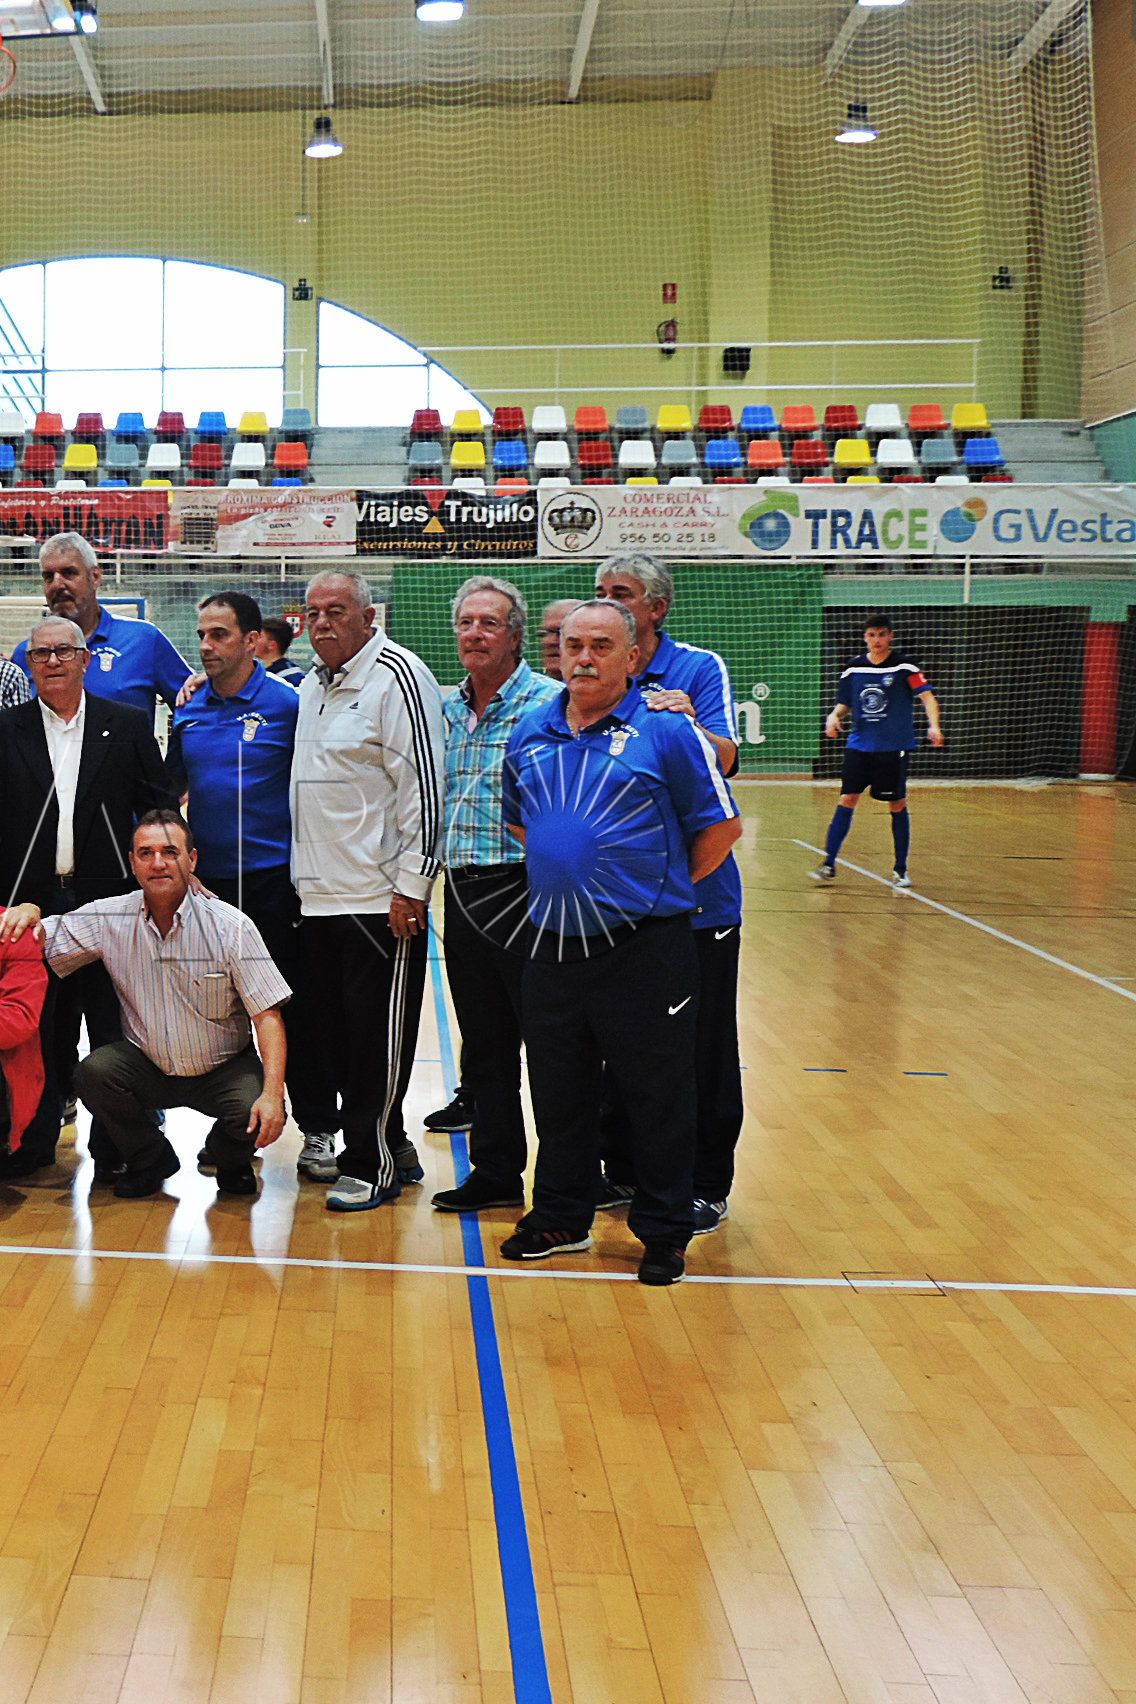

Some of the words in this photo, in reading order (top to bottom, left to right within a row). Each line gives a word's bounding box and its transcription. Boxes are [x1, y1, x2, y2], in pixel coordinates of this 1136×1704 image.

[623, 493, 714, 504] COMERCIAL
[356, 501, 429, 527] Viajes
[445, 501, 535, 528] Trujillo
[607, 506, 696, 518] ZARAGOZA
[804, 508, 929, 550] TRACE
[619, 533, 647, 543] 956
[652, 533, 671, 543] 50
[676, 533, 695, 543] 25
[701, 533, 716, 543] 18
